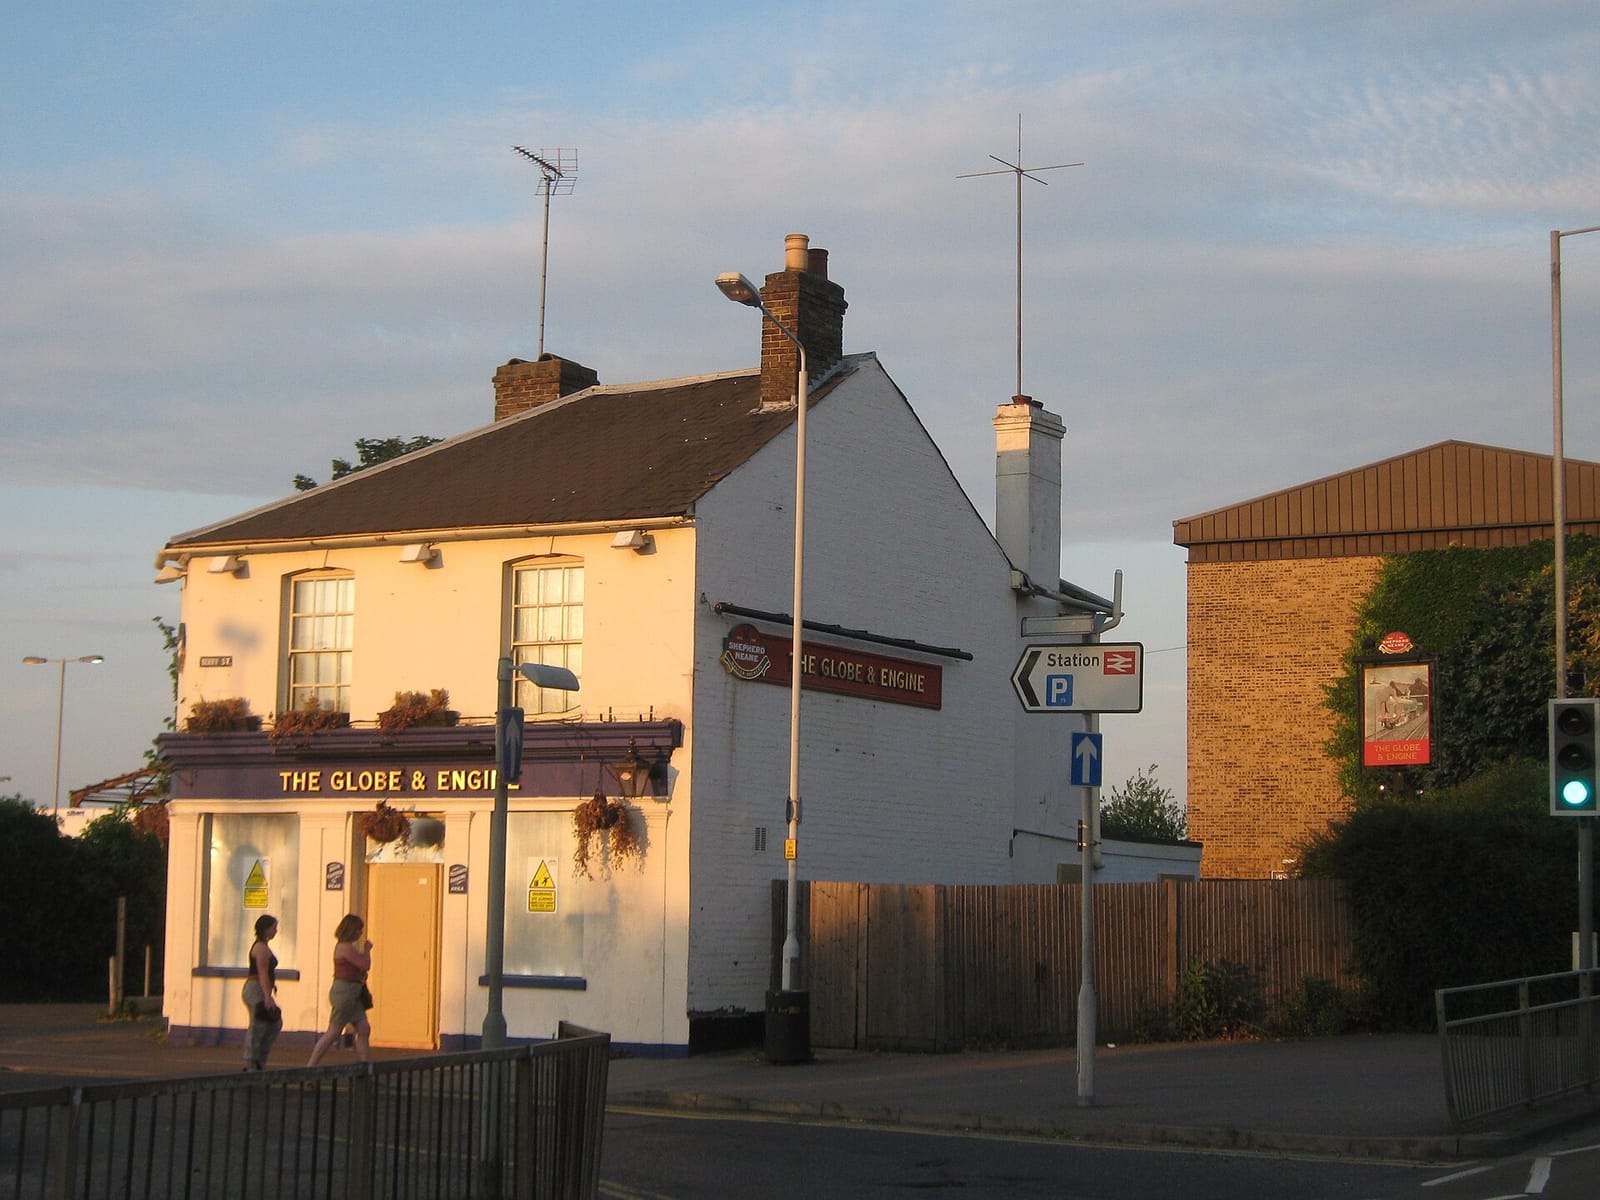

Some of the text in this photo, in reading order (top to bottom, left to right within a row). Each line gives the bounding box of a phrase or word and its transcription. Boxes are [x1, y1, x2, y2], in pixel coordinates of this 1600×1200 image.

[728, 641, 766, 655] SHEPHERD
[734, 651, 760, 663] NEAME
[1047, 653, 1100, 667] Station
[821, 658, 863, 682] GLOBE
[867, 665, 876, 683] &
[881, 668, 925, 692] ENGINE
[1051, 678, 1068, 703] P
[1375, 743, 1421, 752] THE GLOBE
[1386, 752, 1417, 761] ENGINE
[280, 769, 520, 791] THE GLOBE & ENGI
